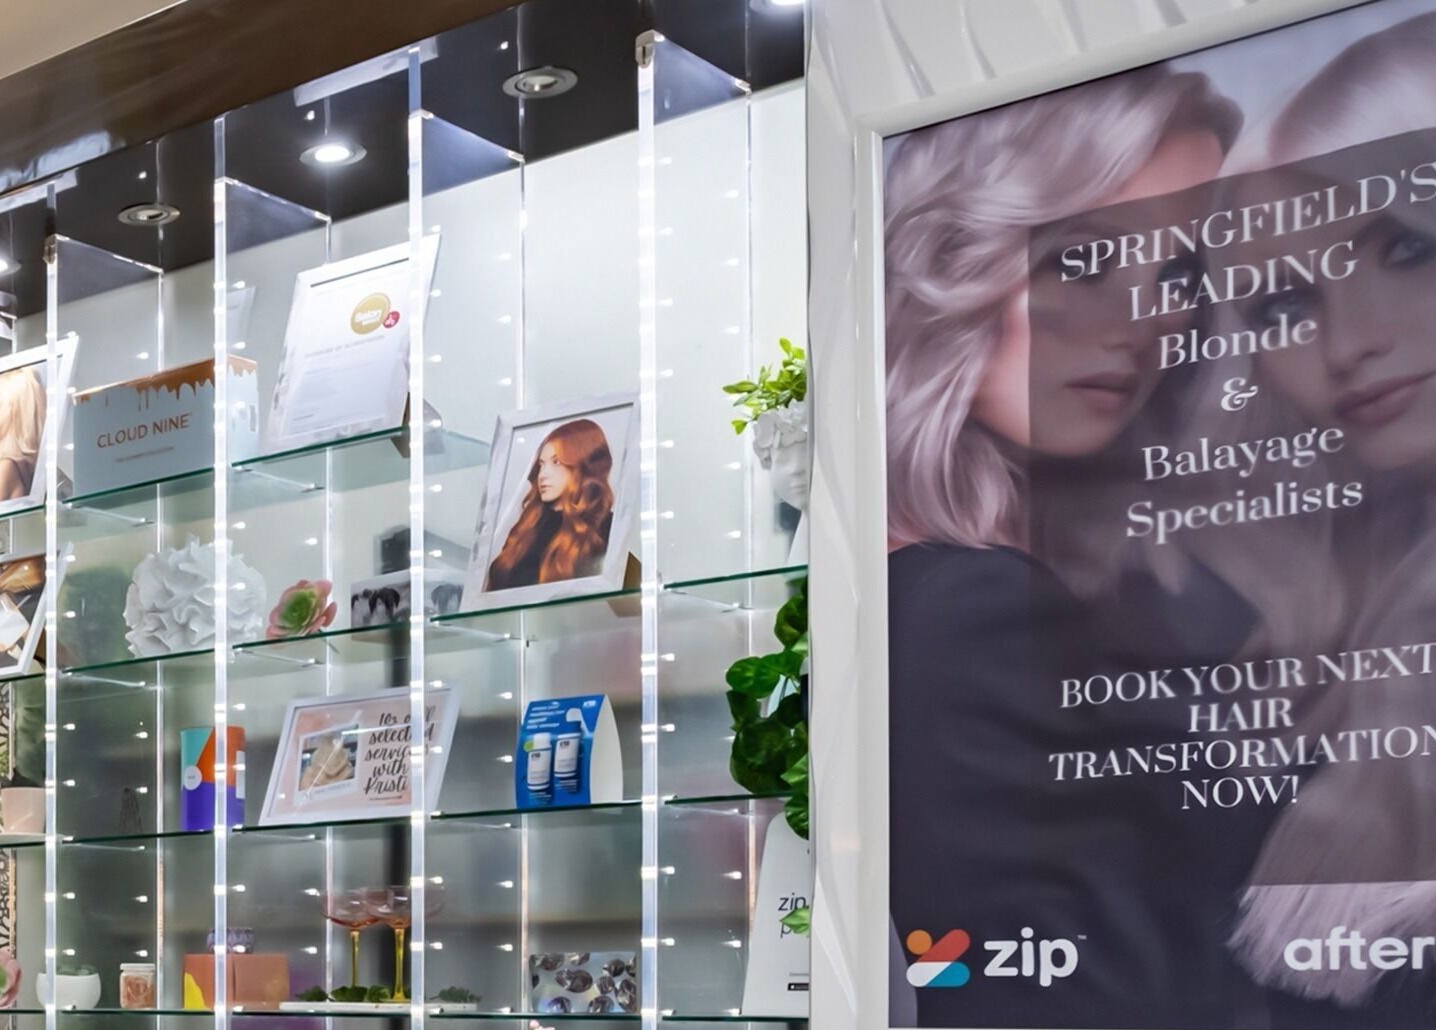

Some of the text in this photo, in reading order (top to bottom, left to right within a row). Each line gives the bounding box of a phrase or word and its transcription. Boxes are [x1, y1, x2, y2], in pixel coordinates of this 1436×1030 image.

[1061, 161, 1436, 282] SPRINGFIELD'S
[1129, 240, 1359, 321] LEADING
[1158, 313, 1317, 370] Blonde
[1220, 377, 1259, 412] &
[97, 412, 191, 448] CLOUD NINE
[1141, 427, 1345, 480] Balayage
[1126, 481, 1364, 544] Specialists
[1060, 642, 1436, 708] BOOK YOUR NEXT
[369, 723, 434, 745] selectd
[1188, 697, 1294, 733] HAIR
[364, 775, 408, 794] Kristi
[1181, 775, 1300, 810] NOW!
[983, 927, 1079, 987] zip
